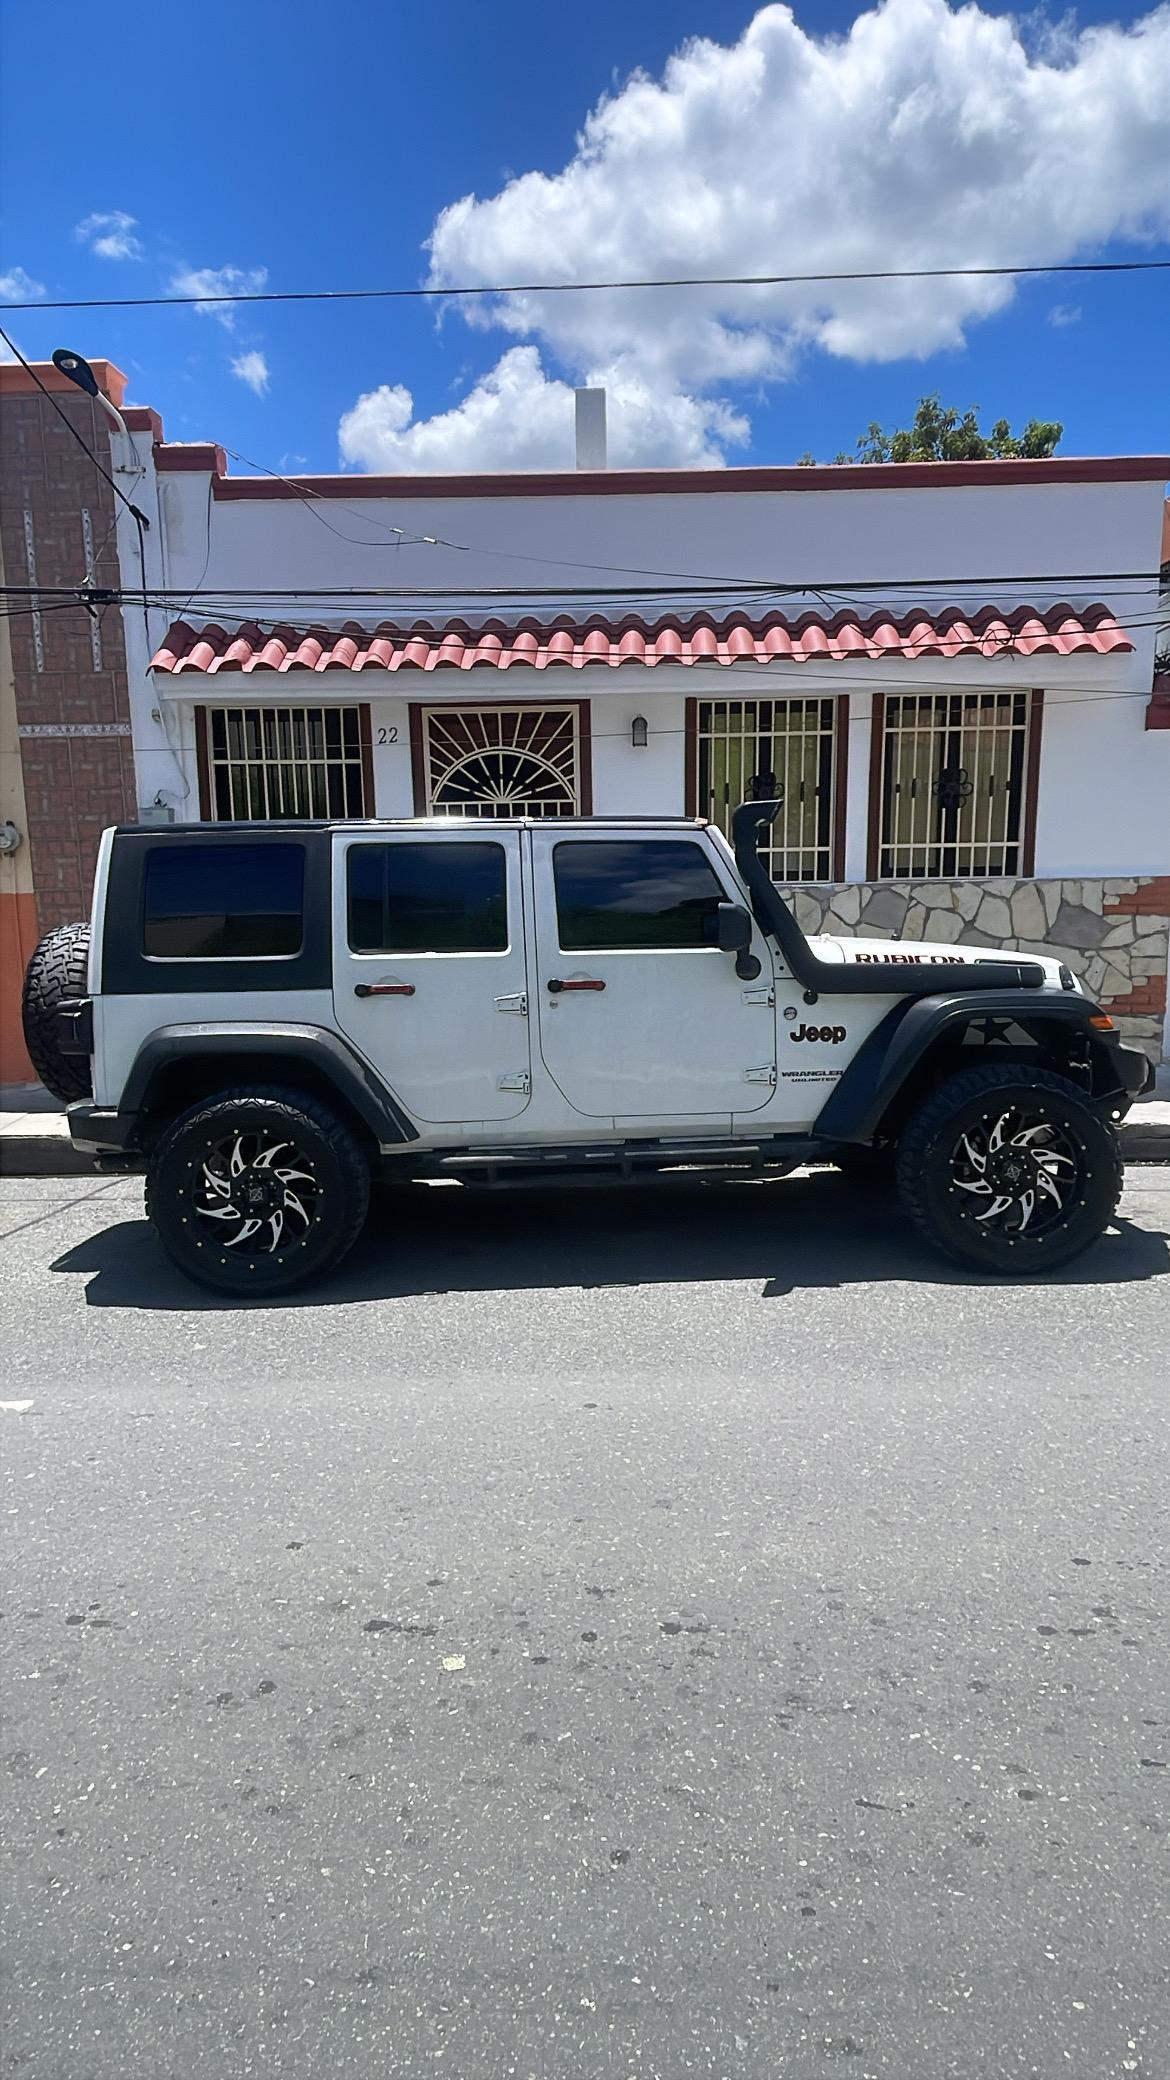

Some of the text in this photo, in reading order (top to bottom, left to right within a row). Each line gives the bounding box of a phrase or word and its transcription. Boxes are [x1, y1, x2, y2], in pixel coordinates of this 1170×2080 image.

[378, 727, 398, 744] 22
[855, 953, 965, 964] RUBICON
[790, 1023, 847, 1045] Jeep
[781, 1070, 844, 1078] WRANGLER
